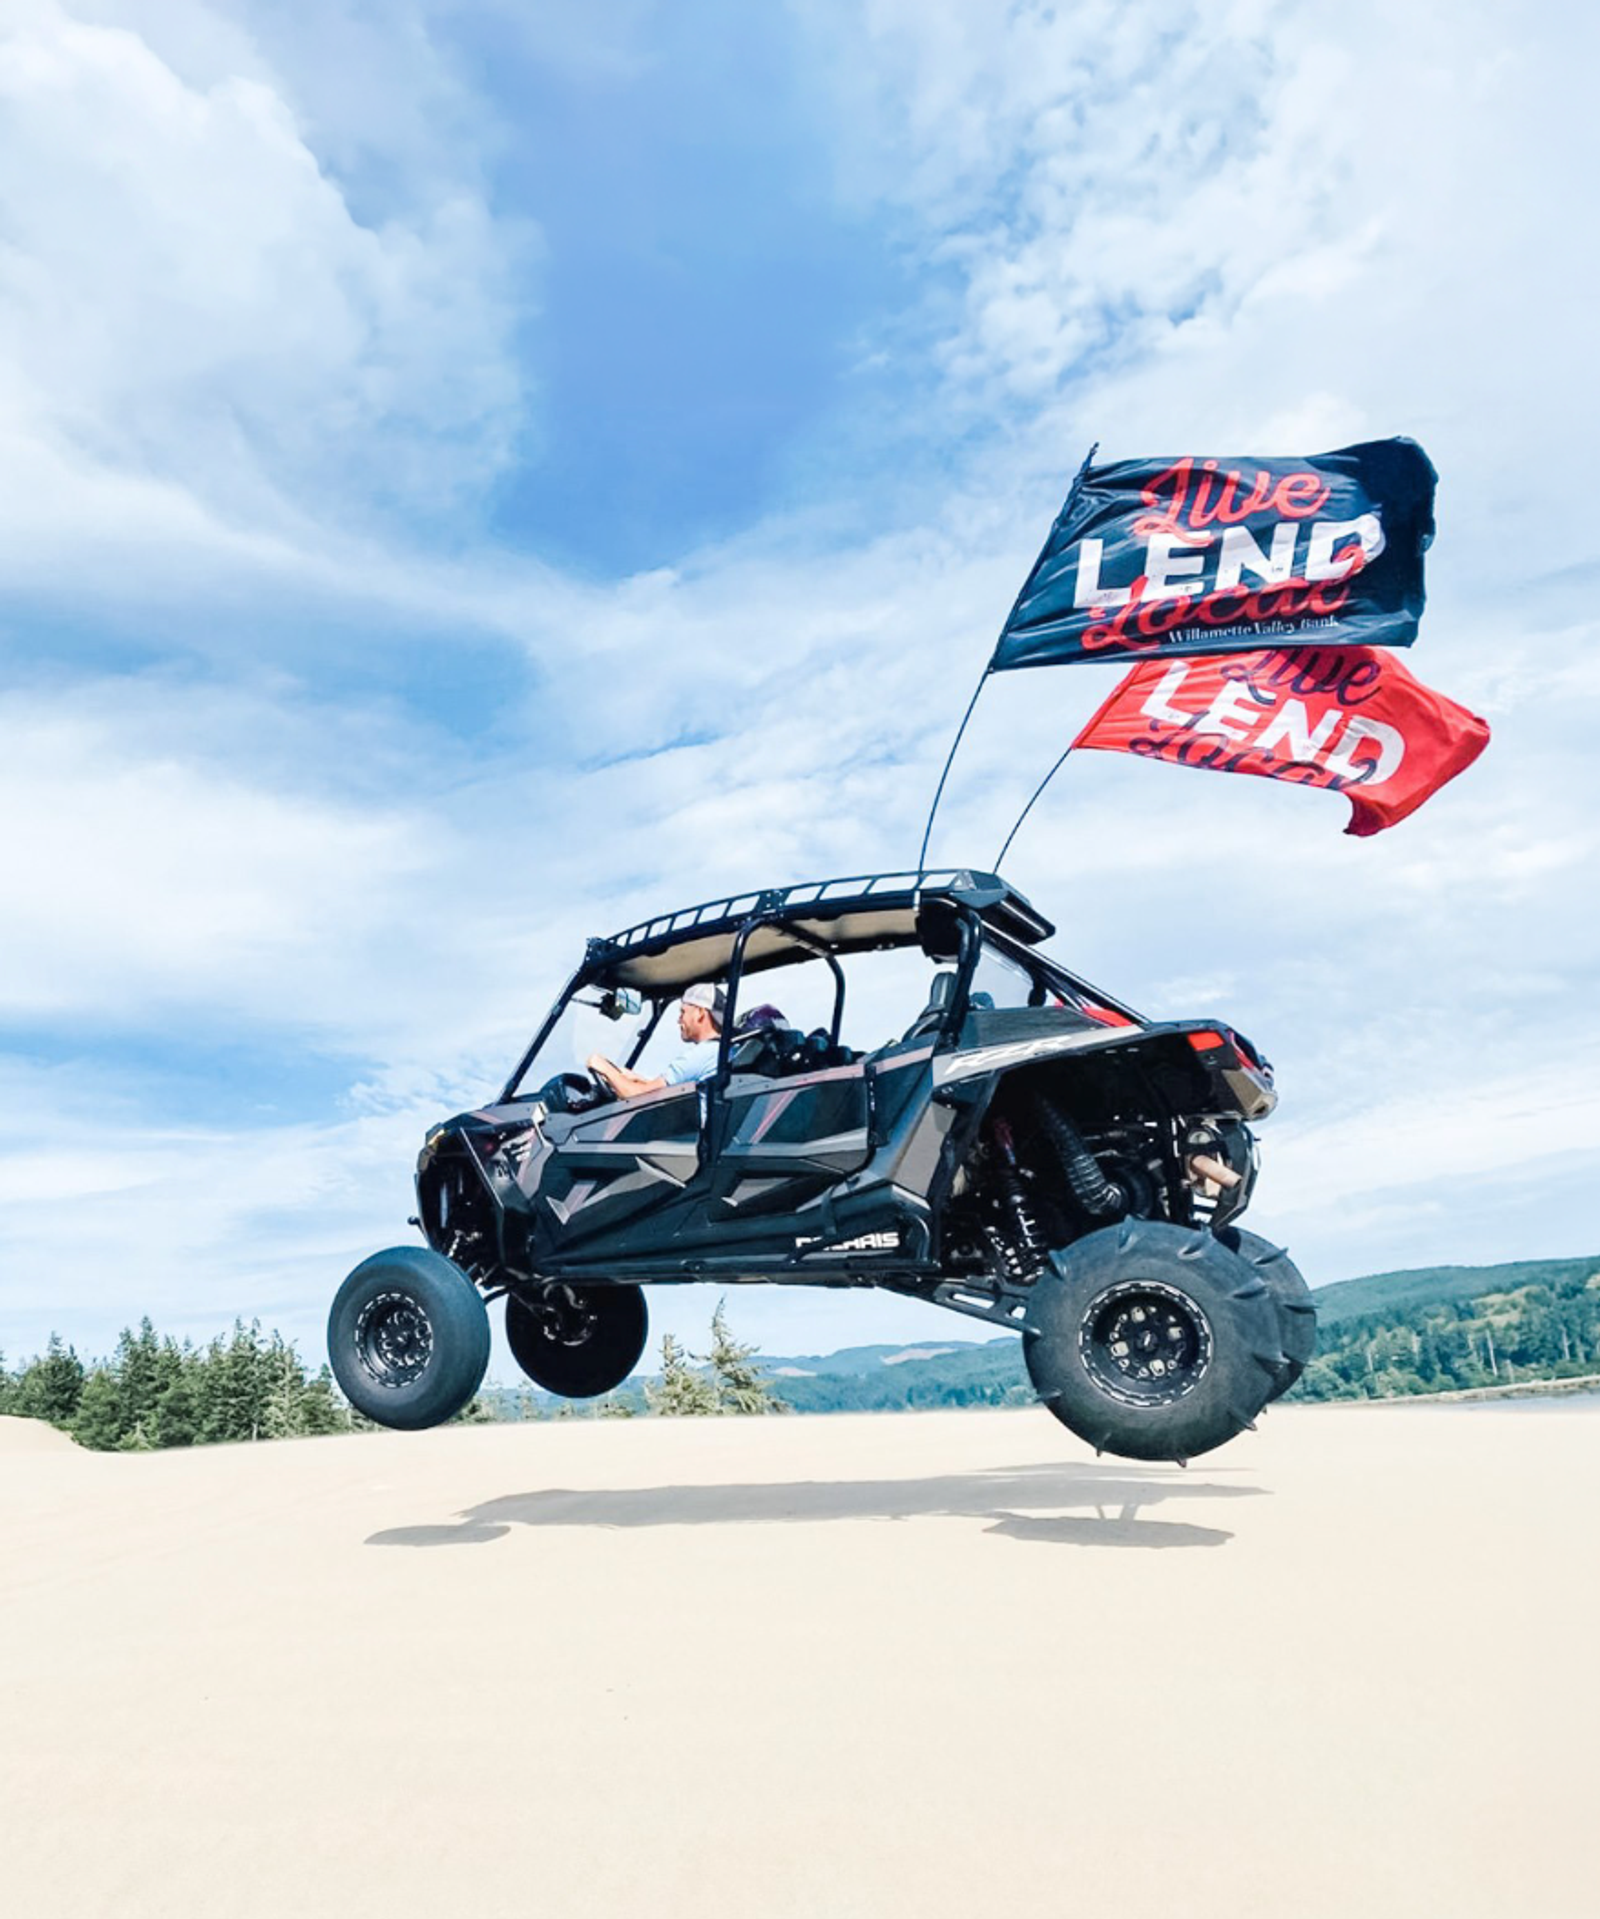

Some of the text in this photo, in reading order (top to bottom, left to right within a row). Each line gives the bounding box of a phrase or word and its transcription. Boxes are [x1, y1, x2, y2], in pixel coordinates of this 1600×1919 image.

[1133, 456, 1331, 546] Live
[1073, 513, 1386, 609] LEND
[1081, 544, 1365, 650] Local
[1169, 624, 1251, 643] Willamette
[1254, 620, 1295, 635] Valley
[1140, 660, 1405, 786] LEND
